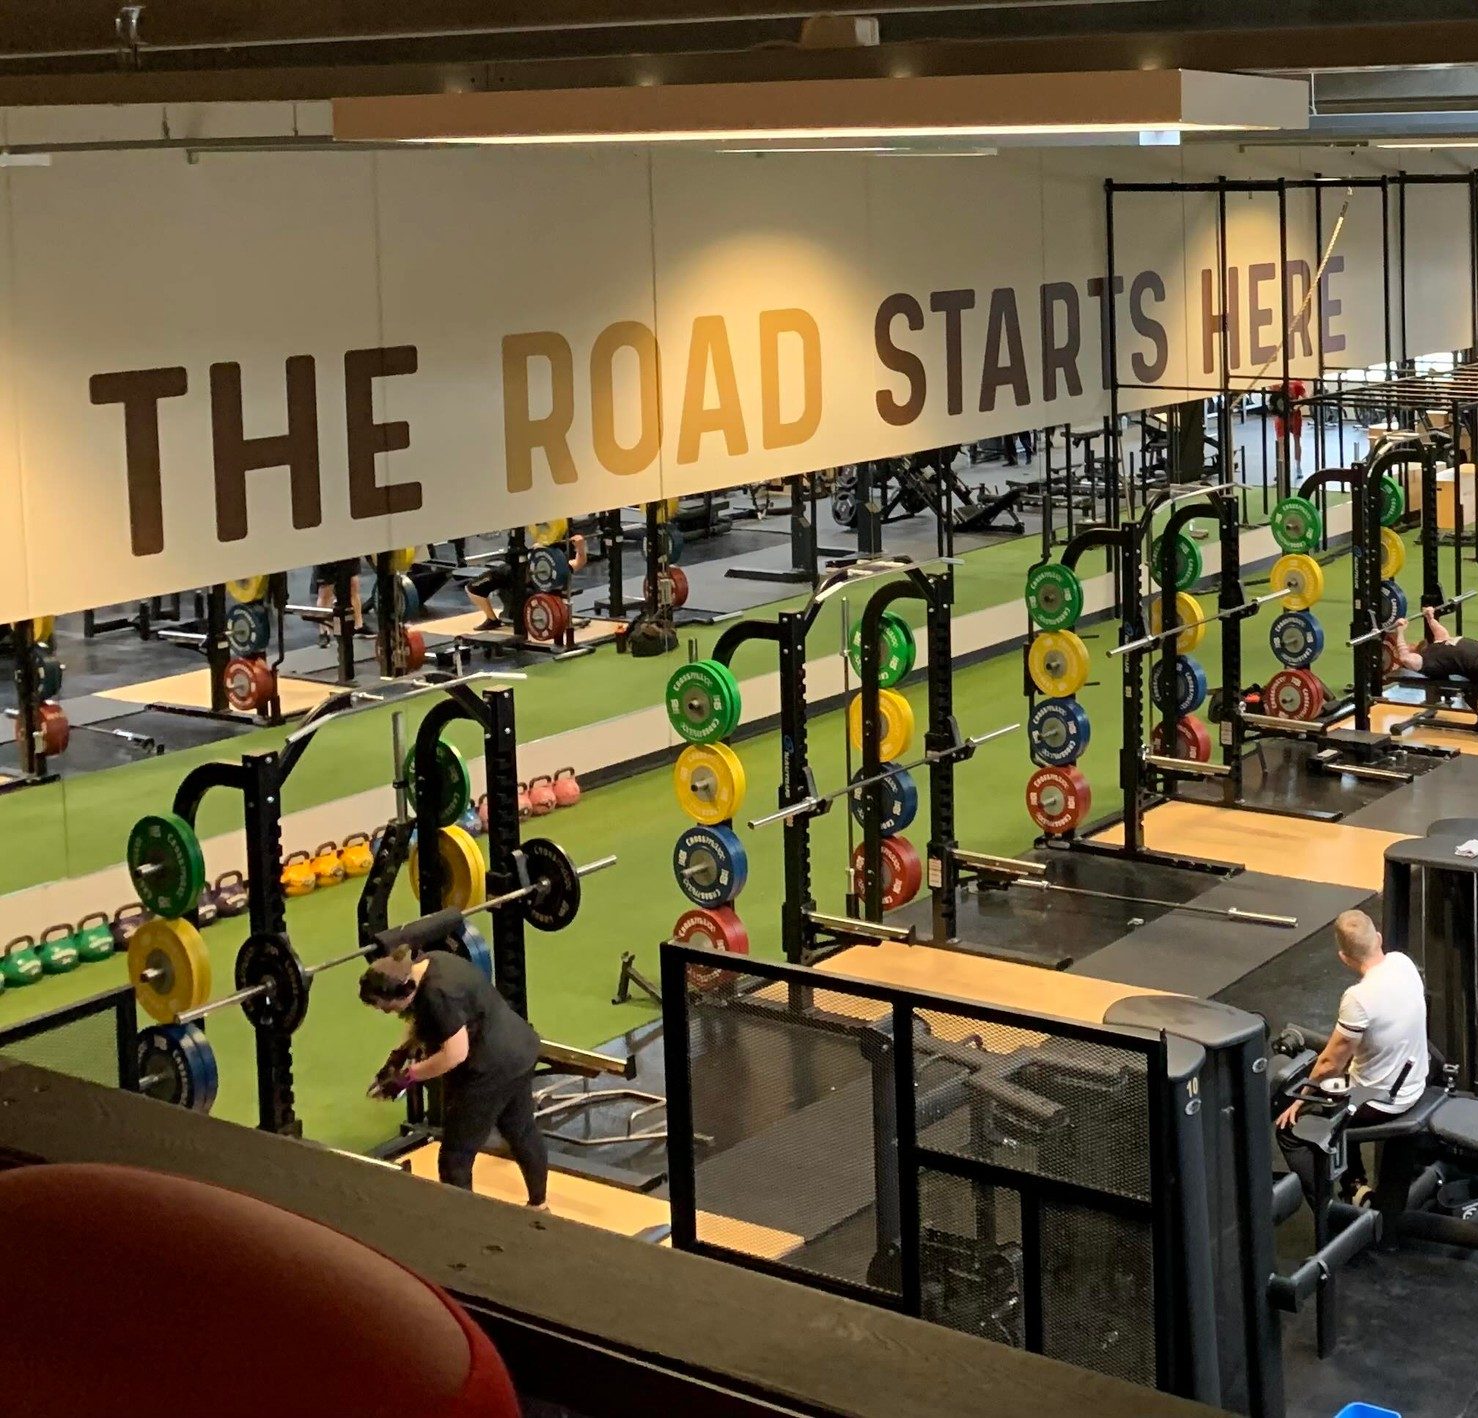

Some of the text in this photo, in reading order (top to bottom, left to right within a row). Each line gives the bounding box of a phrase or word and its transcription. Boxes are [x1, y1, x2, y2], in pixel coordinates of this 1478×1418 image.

[89, 256, 1345, 557] THE ROAD STARTS HERE
[1186, 1077, 1198, 1098] 10
